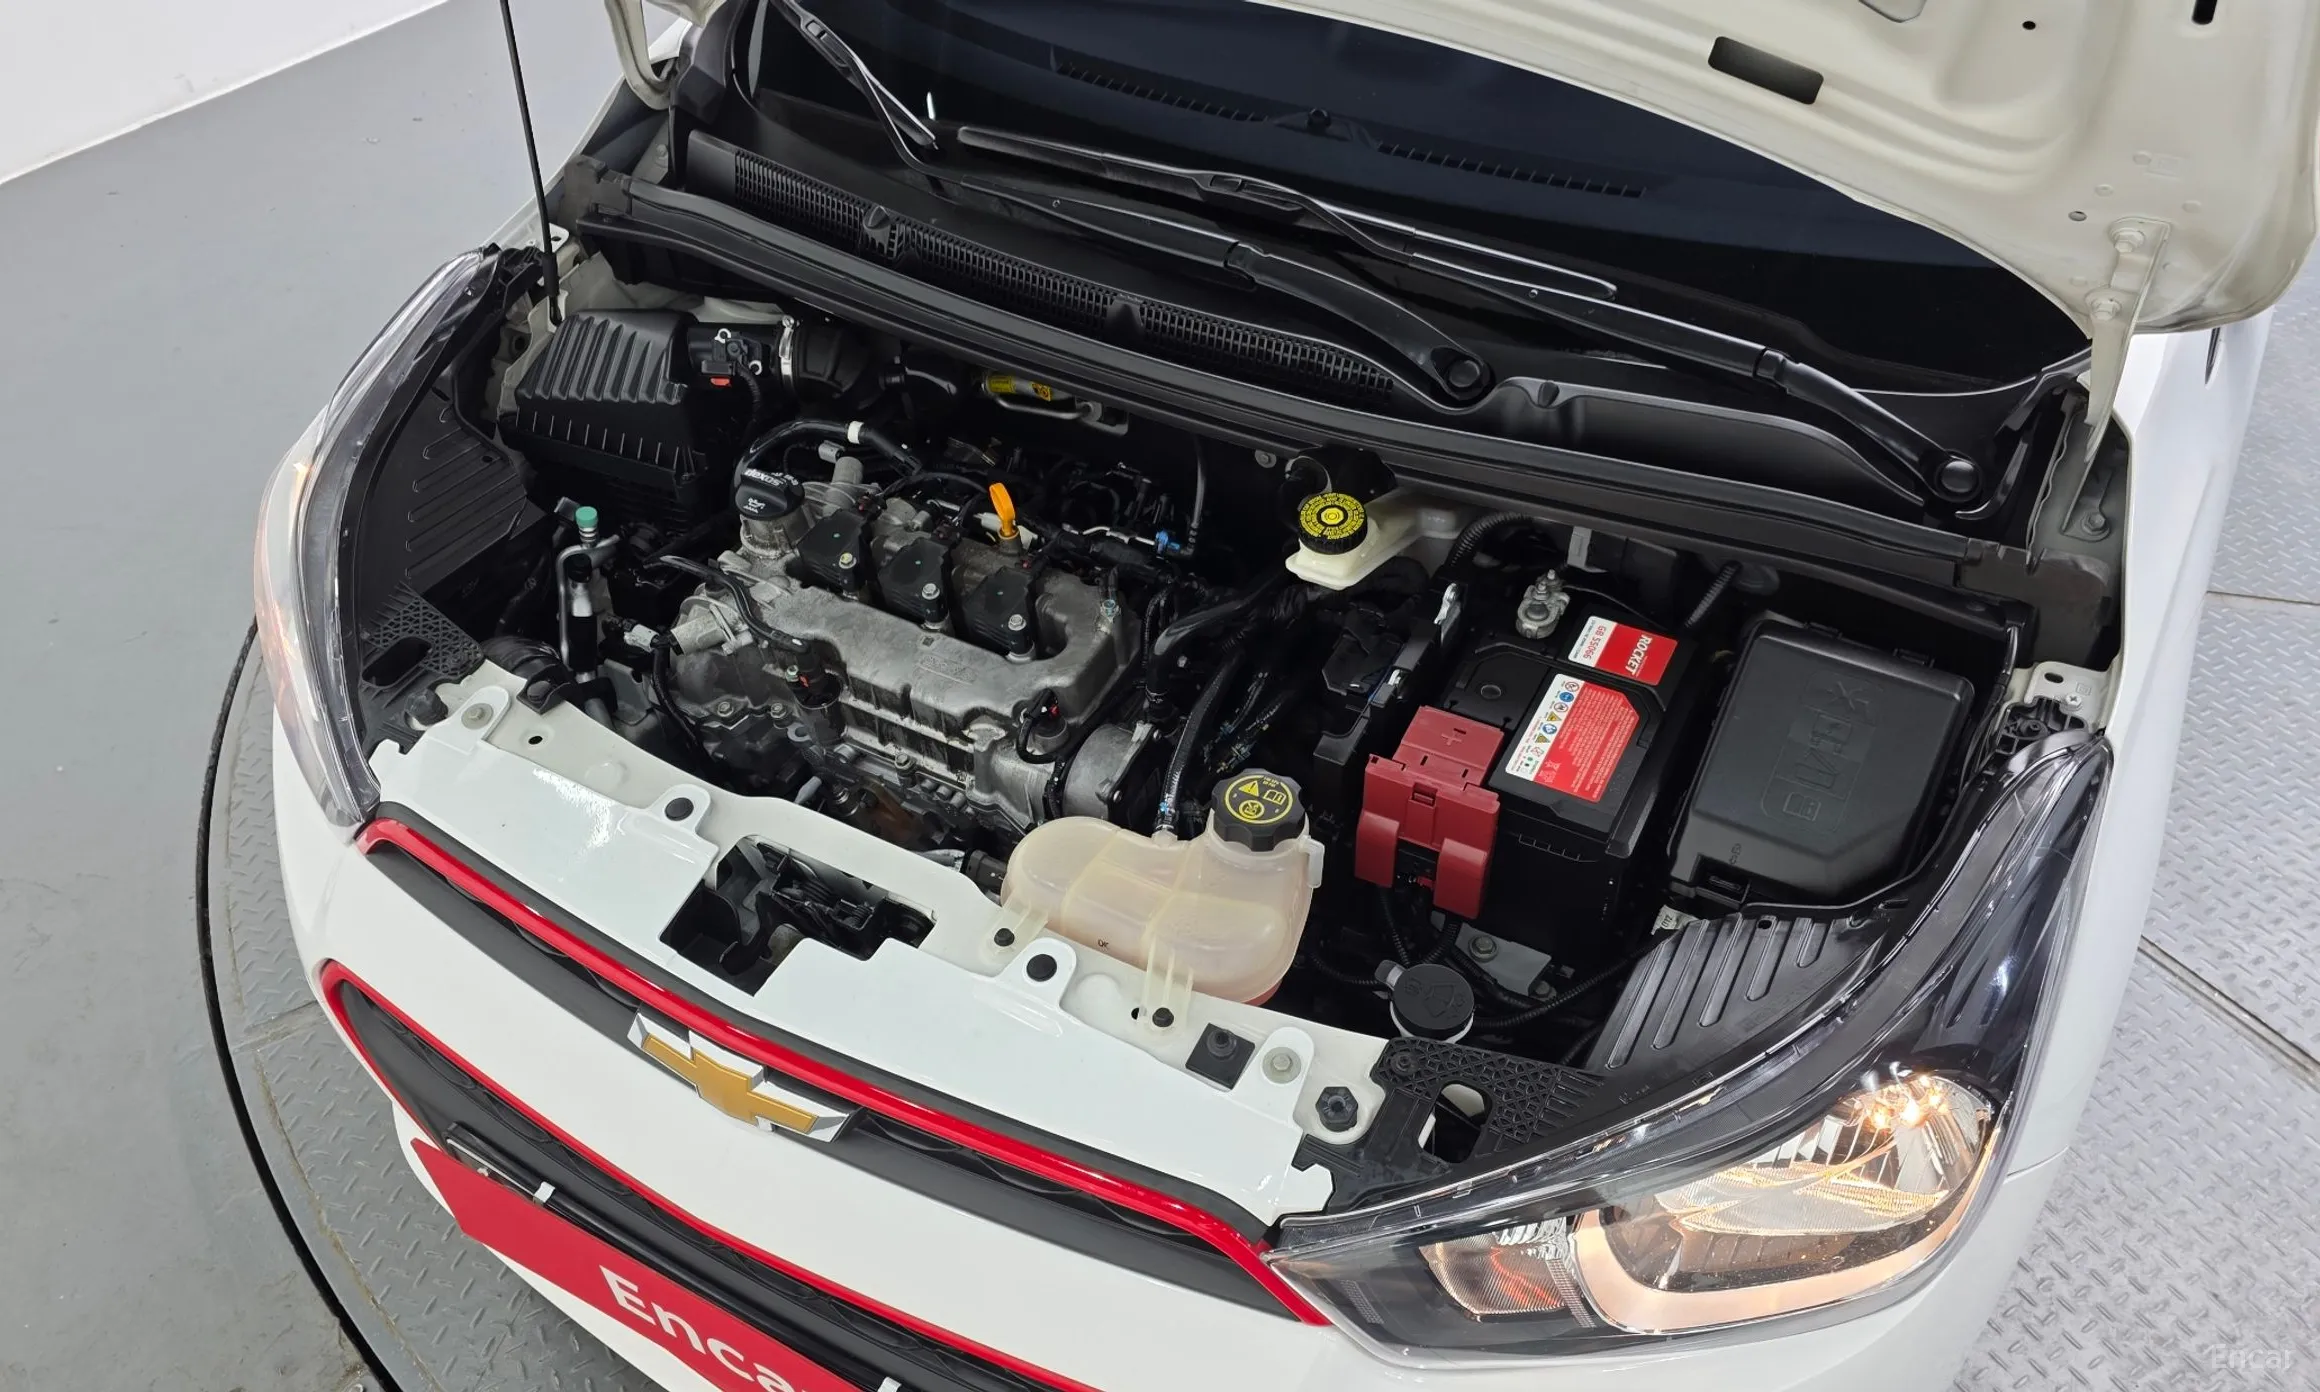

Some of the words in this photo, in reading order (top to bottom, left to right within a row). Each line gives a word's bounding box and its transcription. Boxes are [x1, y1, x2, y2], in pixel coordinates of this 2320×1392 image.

[1595, 625, 1607, 637] GB
[1625, 634, 1653, 676] ROCKET
[599, 1264, 806, 1392] Enca
